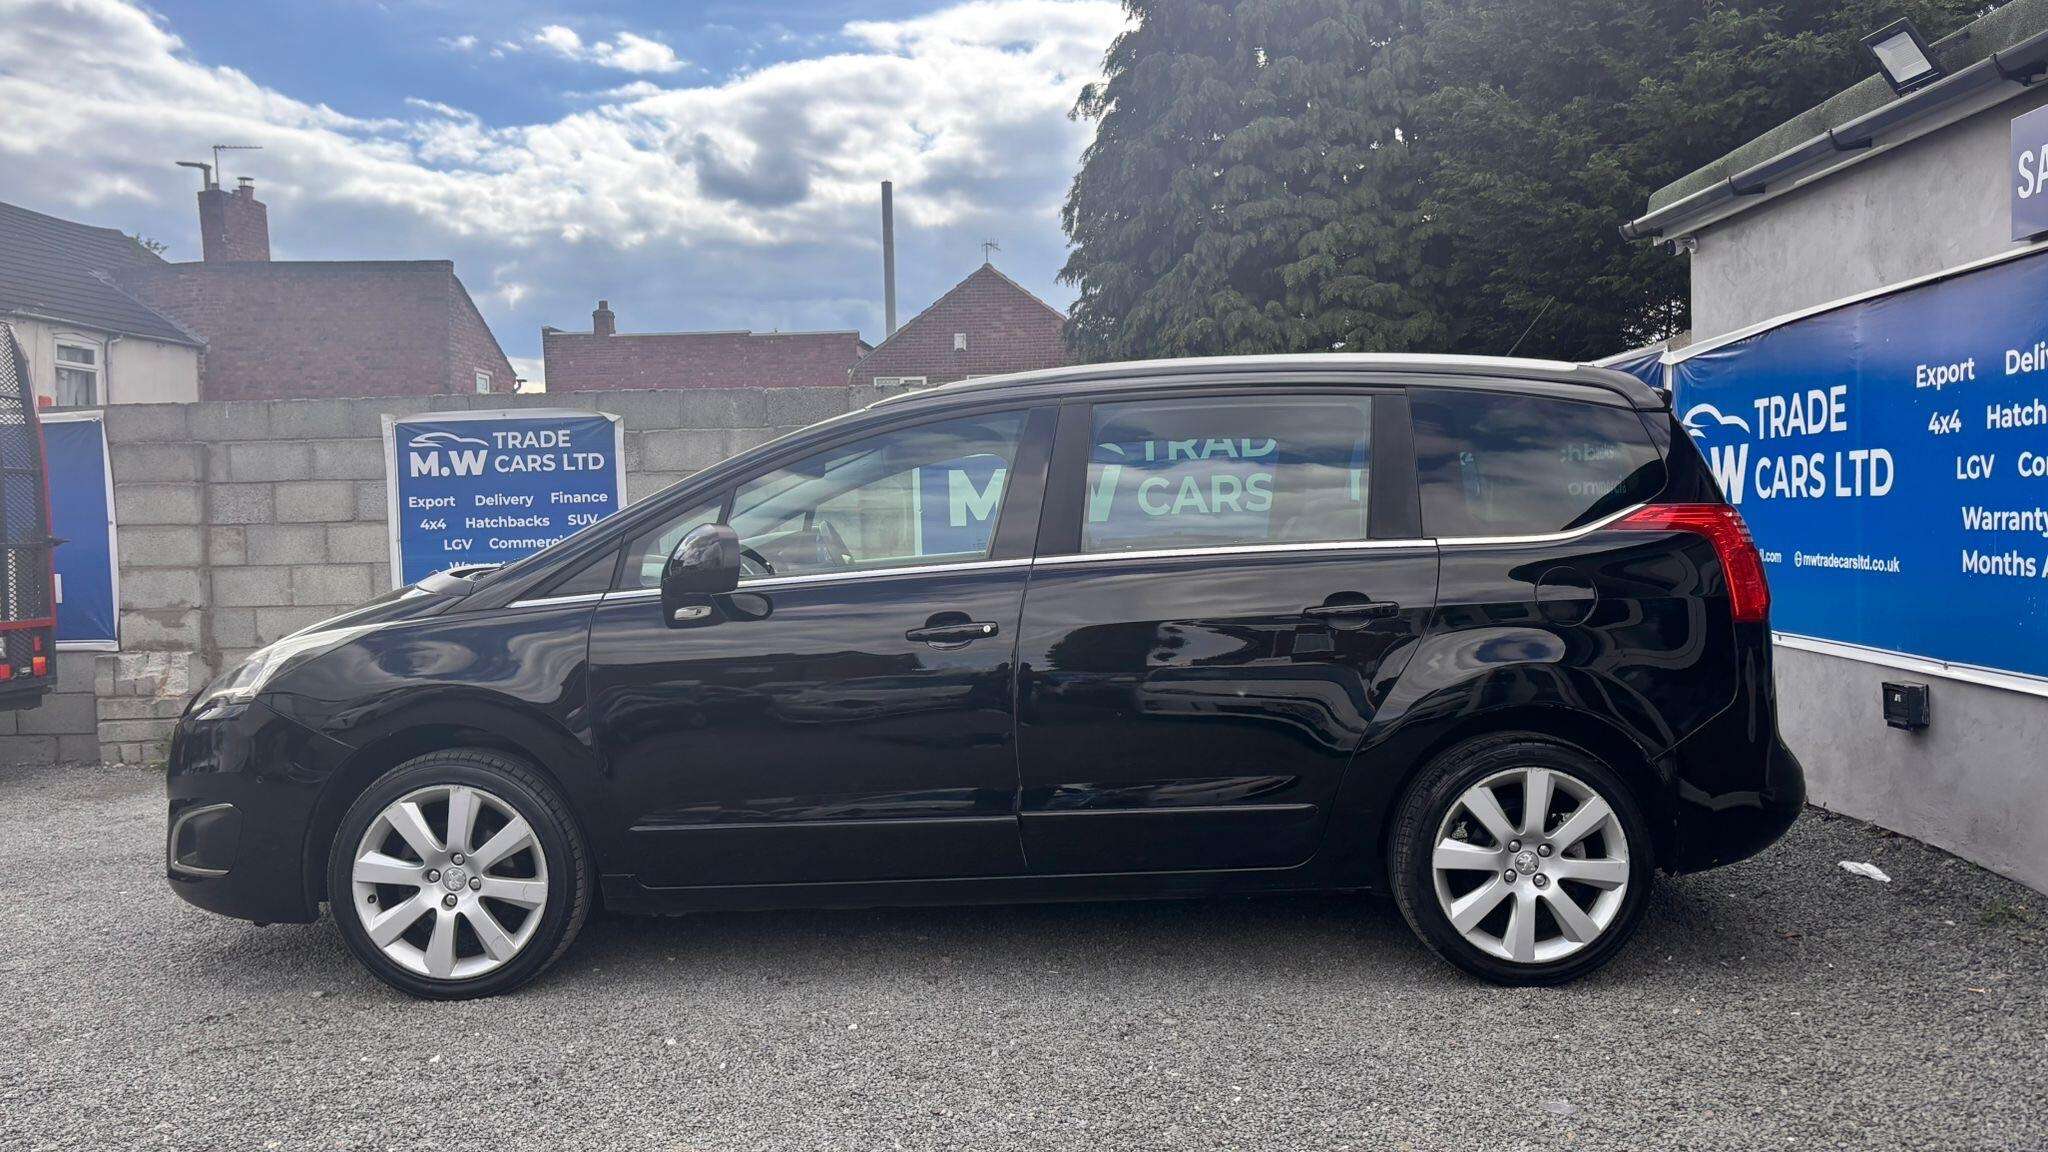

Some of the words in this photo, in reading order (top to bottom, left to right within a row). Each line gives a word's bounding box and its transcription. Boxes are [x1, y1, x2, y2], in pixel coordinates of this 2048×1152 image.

[1916, 357, 1975, 390] Export
[2005, 341, 2048, 375] Deli
[1754, 385, 1847, 440] TRADE
[1928, 409, 1961, 435] 4x4
[1986, 398, 2047, 430] Hatch
[493, 430, 571, 449] TRADE
[409, 450, 488, 477] M.W
[495, 454, 556, 473] CARS
[563, 452, 605, 471] LTD
[1755, 452, 1826, 499] CARS
[1835, 448, 1894, 498] LTD
[1956, 455, 1995, 480] LGV
[2018, 451, 2048, 477] Co
[409, 496, 456, 510] Export
[475, 493, 534, 508] Delivery
[551, 491, 608, 504] Finance
[1138, 472, 1273, 516] CARS
[420, 519, 446, 530] 4x4
[466, 515, 550, 529] Hatchbacks
[444, 538, 473, 551] LGV
[489, 535, 563, 550] Commer
[1803, 553, 1900, 573] mwtradecarsltd.co.uk
[1962, 550, 2036, 578] Months
